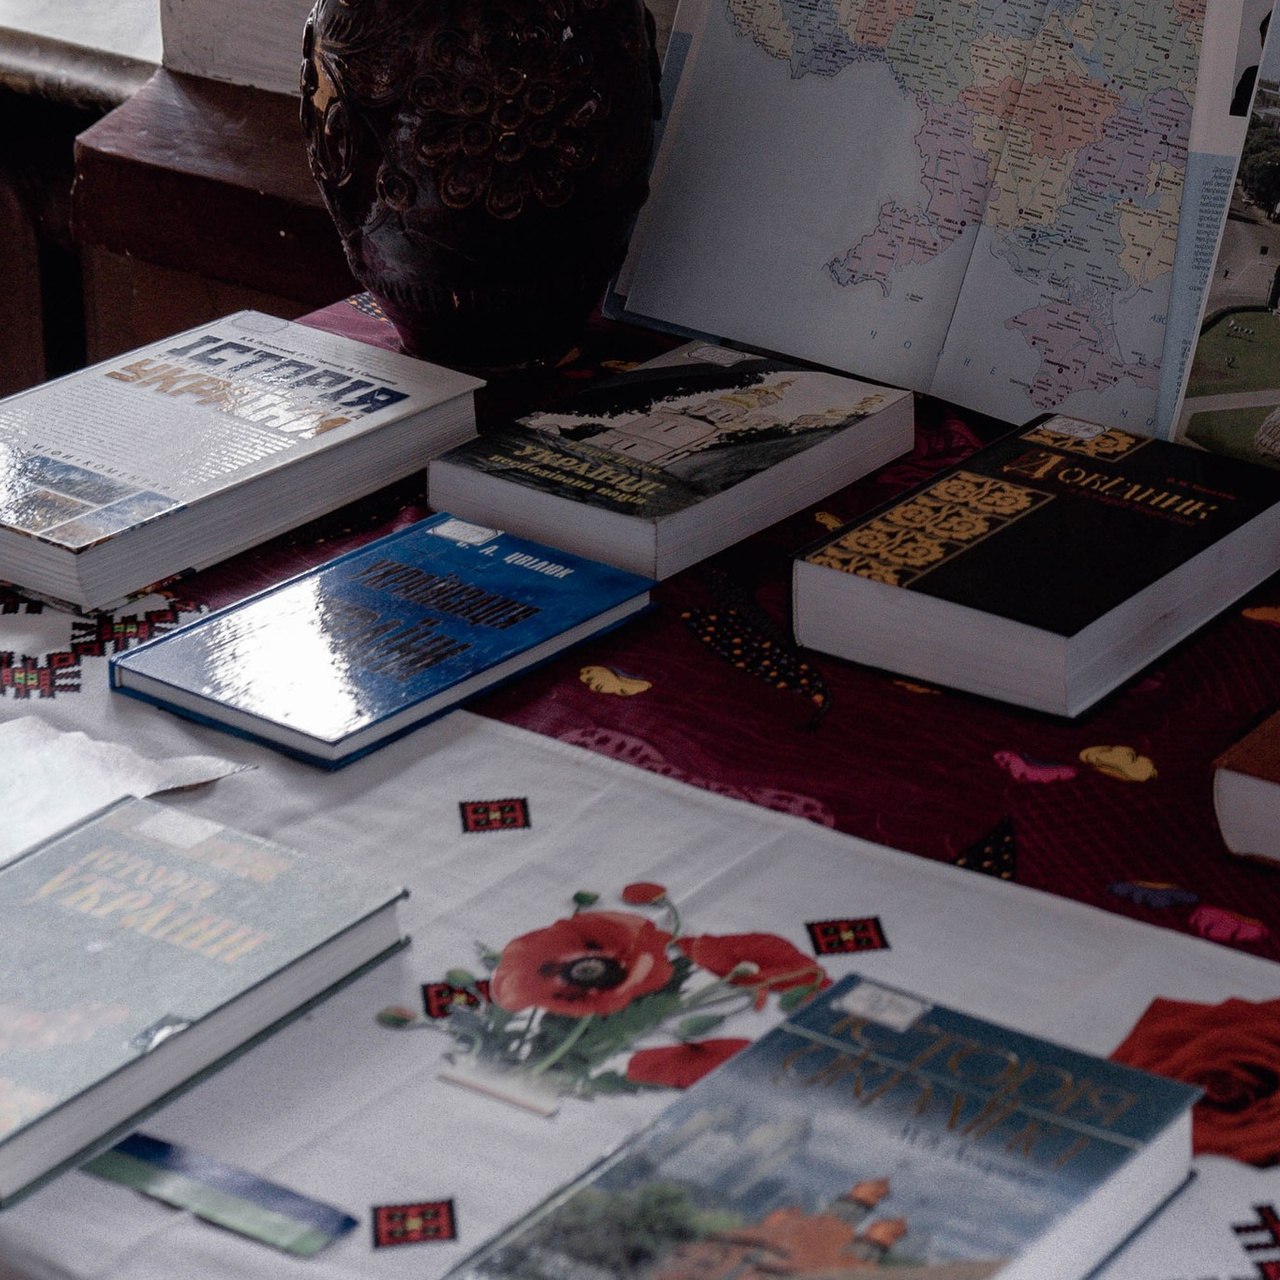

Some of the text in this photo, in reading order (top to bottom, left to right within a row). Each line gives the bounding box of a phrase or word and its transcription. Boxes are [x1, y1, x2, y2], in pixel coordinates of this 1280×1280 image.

[167, 334, 411, 414] ІСТОРІЯ
[345, 558, 542, 631] УКРАЇНІЗАЦІЯ
[504, 551, 574, 580] ЦВІЛЮК
[27, 866, 276, 962] УКРАЇНИ
